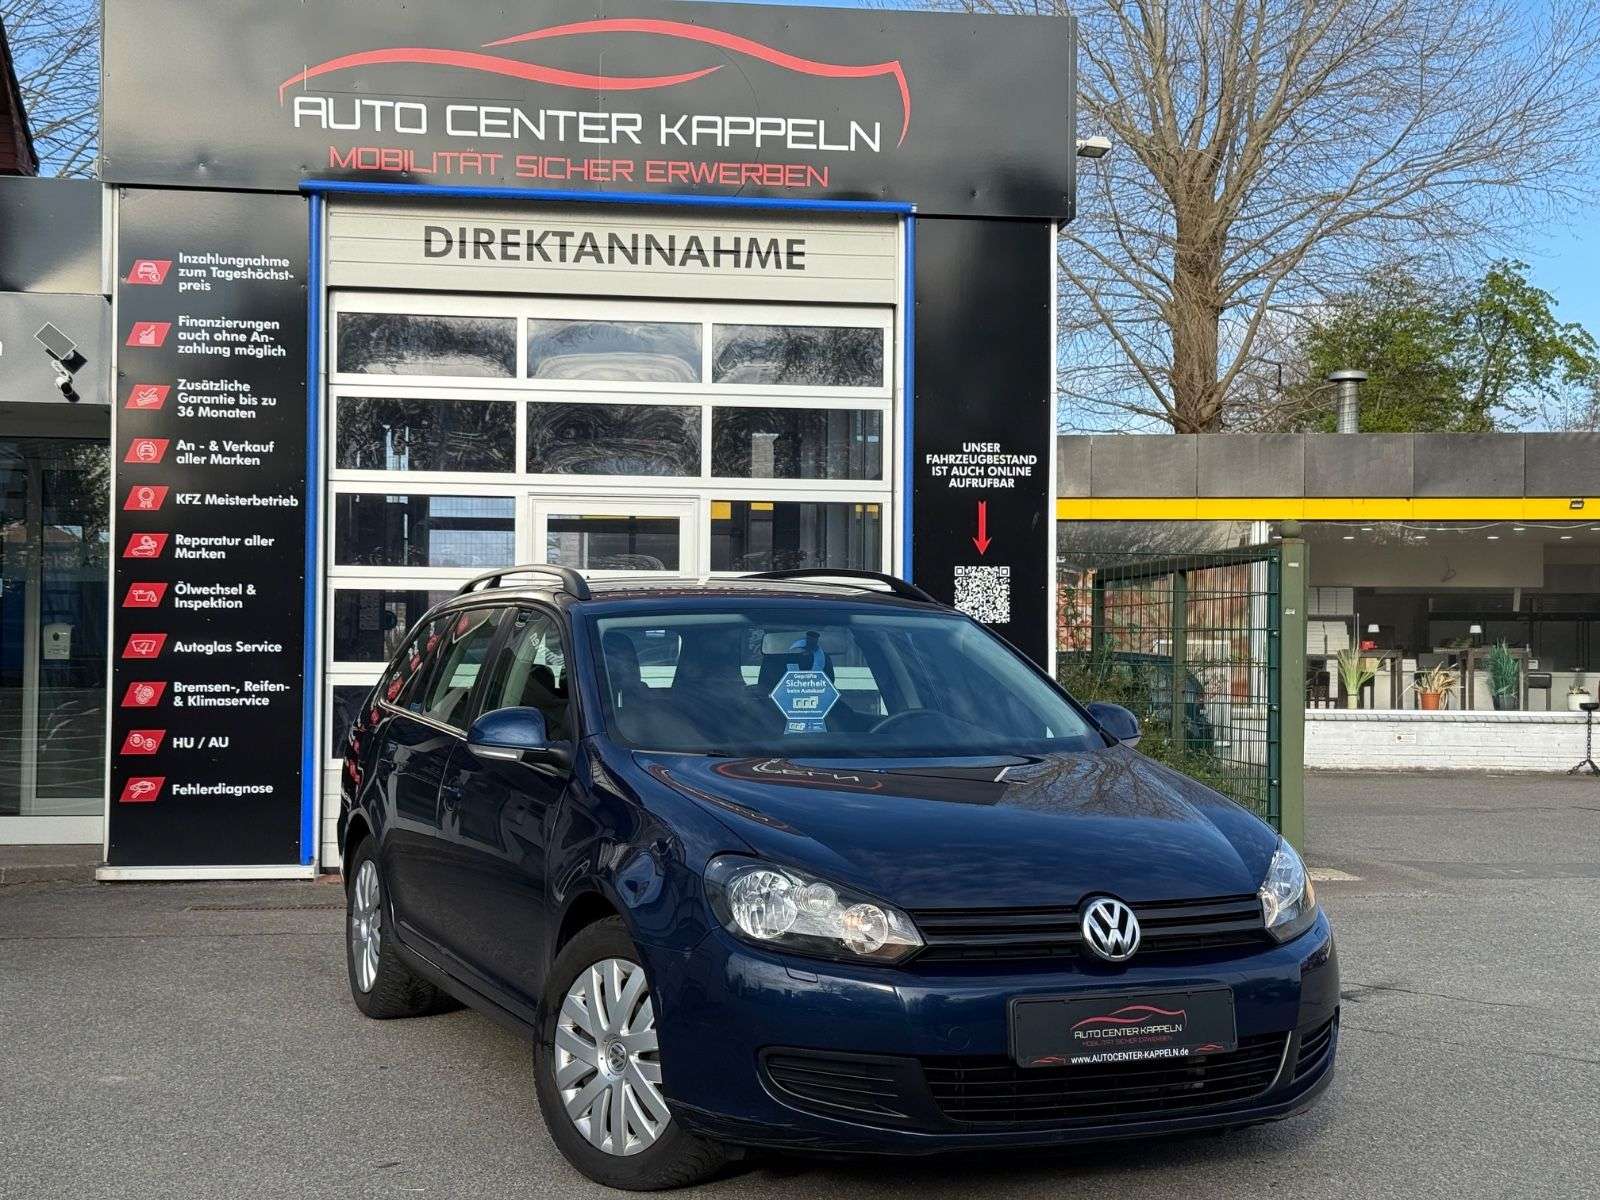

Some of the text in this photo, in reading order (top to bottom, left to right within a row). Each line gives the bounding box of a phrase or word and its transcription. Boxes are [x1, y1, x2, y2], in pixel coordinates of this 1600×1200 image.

[293, 96, 881, 153] AUTO CENTER KAPPELN
[328, 145, 830, 188] MOBILITÄT SICHER ERWERBEN
[423, 225, 806, 271] DIREKTANNAHME
[178, 252, 289, 269] Inzahlungnahme
[178, 267, 295, 281] zum Tageshöchst-
[178, 279, 211, 293] preis
[178, 315, 280, 332] Finanzierungen
[178, 330, 274, 343] auch ohne An-
[177, 344, 287, 359] zahlung möglich
[177, 378, 251, 392] Zusätzliche
[177, 392, 277, 406] Garantie bis zu
[177, 406, 256, 419] 36 Monaten
[176, 440, 195, 451] An
[209, 440, 219, 452] &
[223, 441, 275, 453] Verkauf
[962, 442, 1001, 453] UNSER
[176, 453, 261, 466] aller Marken
[926, 454, 1037, 465] FAHRZEUGBESTAND
[931, 466, 1032, 477] IST AUCH ONLINE
[949, 478, 1015, 488] AUFRUFBAR
[176, 493, 299, 507] KFZ Meisterbetrieb
[174, 534, 275, 548] Reparatur aller
[174, 548, 226, 560] Marken
[174, 580, 257, 596] Ölwechsel &
[174, 597, 243, 611] Inspektion
[173, 640, 283, 655] Autoglas Service
[173, 680, 291, 694] Bremsen-, Reifen-
[786, 679, 827, 687] Sicherheit
[173, 694, 270, 707] & Klimaservice
[172, 737, 229, 749] HU / AU
[172, 783, 274, 797] Fehlerdiagnose
[1084, 899, 1140, 961] VW
[1074, 1024, 1183, 1040] AUTO CENTER KAPPELN
[1071, 1048, 1189, 1064] www.AUTOCENTER-KAPPELN.de
